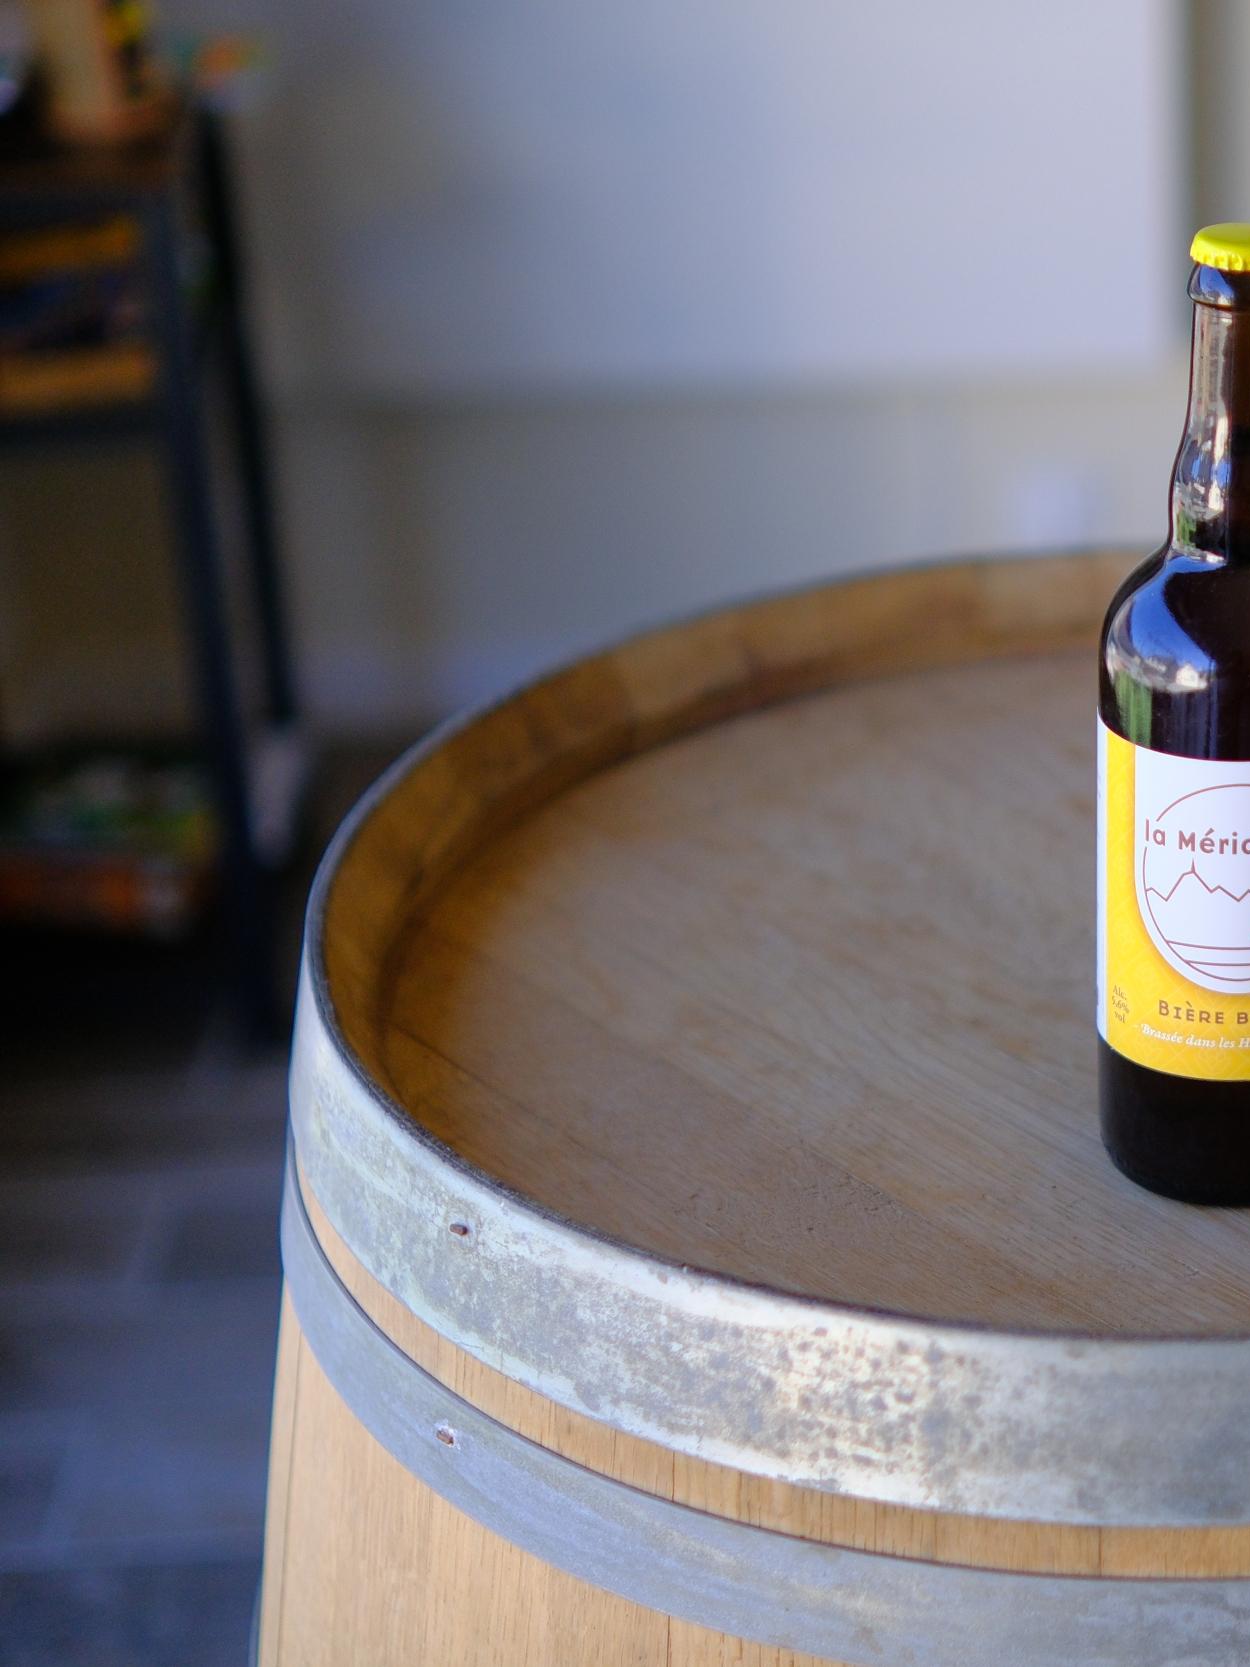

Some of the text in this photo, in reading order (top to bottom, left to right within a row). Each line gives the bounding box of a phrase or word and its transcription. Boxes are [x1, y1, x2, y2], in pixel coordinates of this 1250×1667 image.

[1145, 818, 1167, 847] la
[1141, 1023, 1183, 1043] Brassée
[1185, 1034, 1217, 1048] dans
[1218, 1036, 1235, 1049] les
